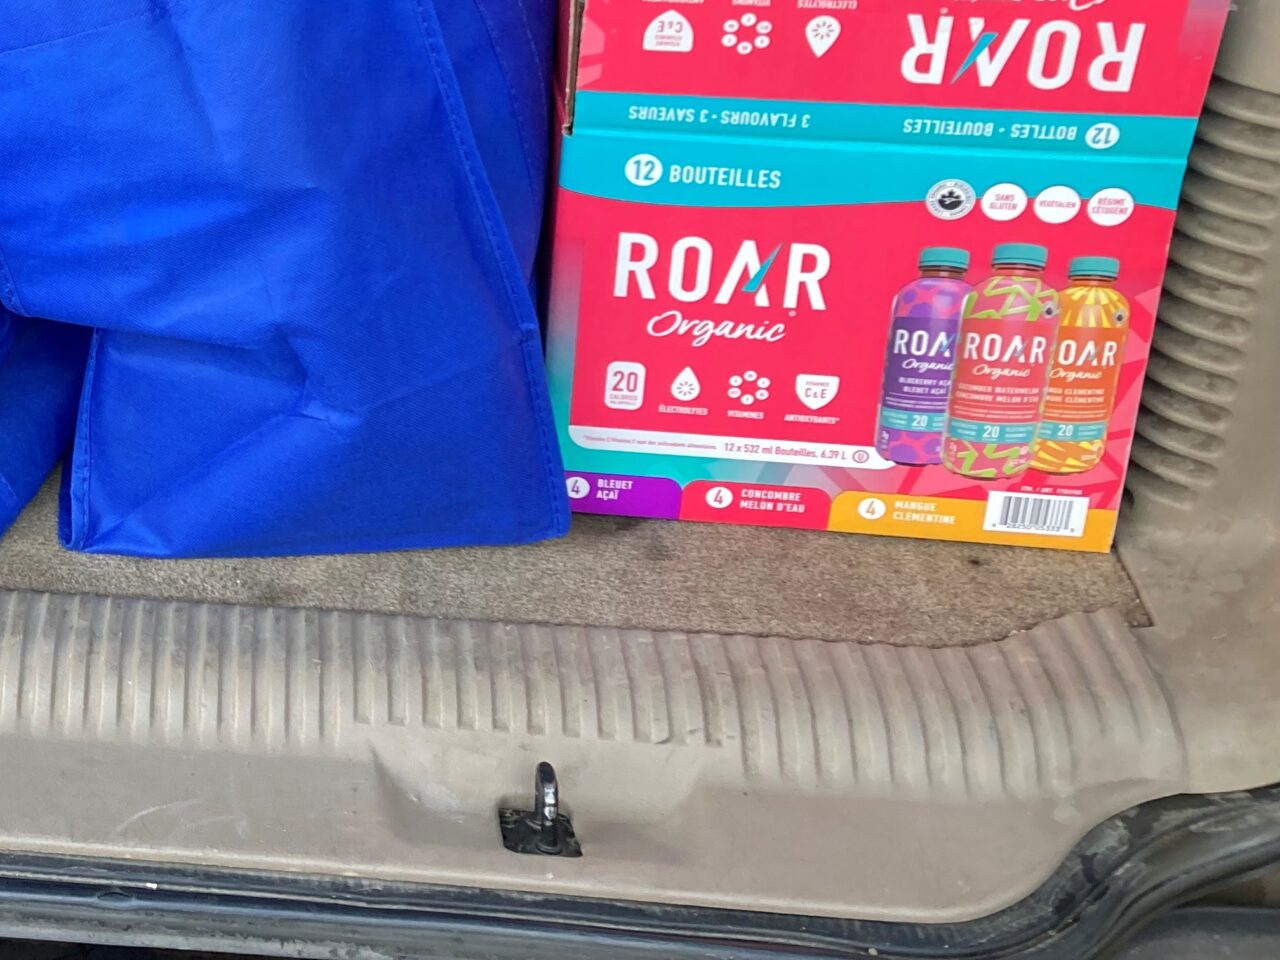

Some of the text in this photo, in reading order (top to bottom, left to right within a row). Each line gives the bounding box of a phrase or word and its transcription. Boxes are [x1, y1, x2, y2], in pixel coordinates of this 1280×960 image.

[900, 13, 1146, 93] ROAR
[628, 105, 811, 128] 3 FLAVOURS 3 SAVEURS
[902, 118, 1113, 146] 12 BOTTLES BOUTEILLES
[632, 159, 782, 189] 12 BOUTEILLES
[988, 201, 1018, 211] GLUTEN
[994, 193, 1015, 202] SANS
[613, 231, 831, 311] ROAR
[646, 310, 787, 348] Organic
[893, 328, 959, 358] ROA
[963, 331, 1047, 364] ROAR
[1052, 340, 1118, 367] OAR
[972, 363, 1031, 380] Organic
[1049, 366, 1103, 382] Organic
[612, 370, 639, 392] 20
[727, 409, 765, 420] VITAMINES
[911, 414, 928, 427] 20
[983, 425, 1000, 438] 20
[1057, 423, 1073, 437] 20
[723, 442, 734, 452] 12
[743, 443, 760, 454] 532
[761, 444, 773, 455] ml
[841, 450, 847, 460] L
[570, 478, 634, 496] 4 BLEUET
[713, 488, 802, 505] 4 CONCOMBRE
[739, 499, 806, 514] MELON D'EAU
[864, 499, 938, 516] 4 MANGUE
[892, 510, 956, 525] CLÉMENTINE
